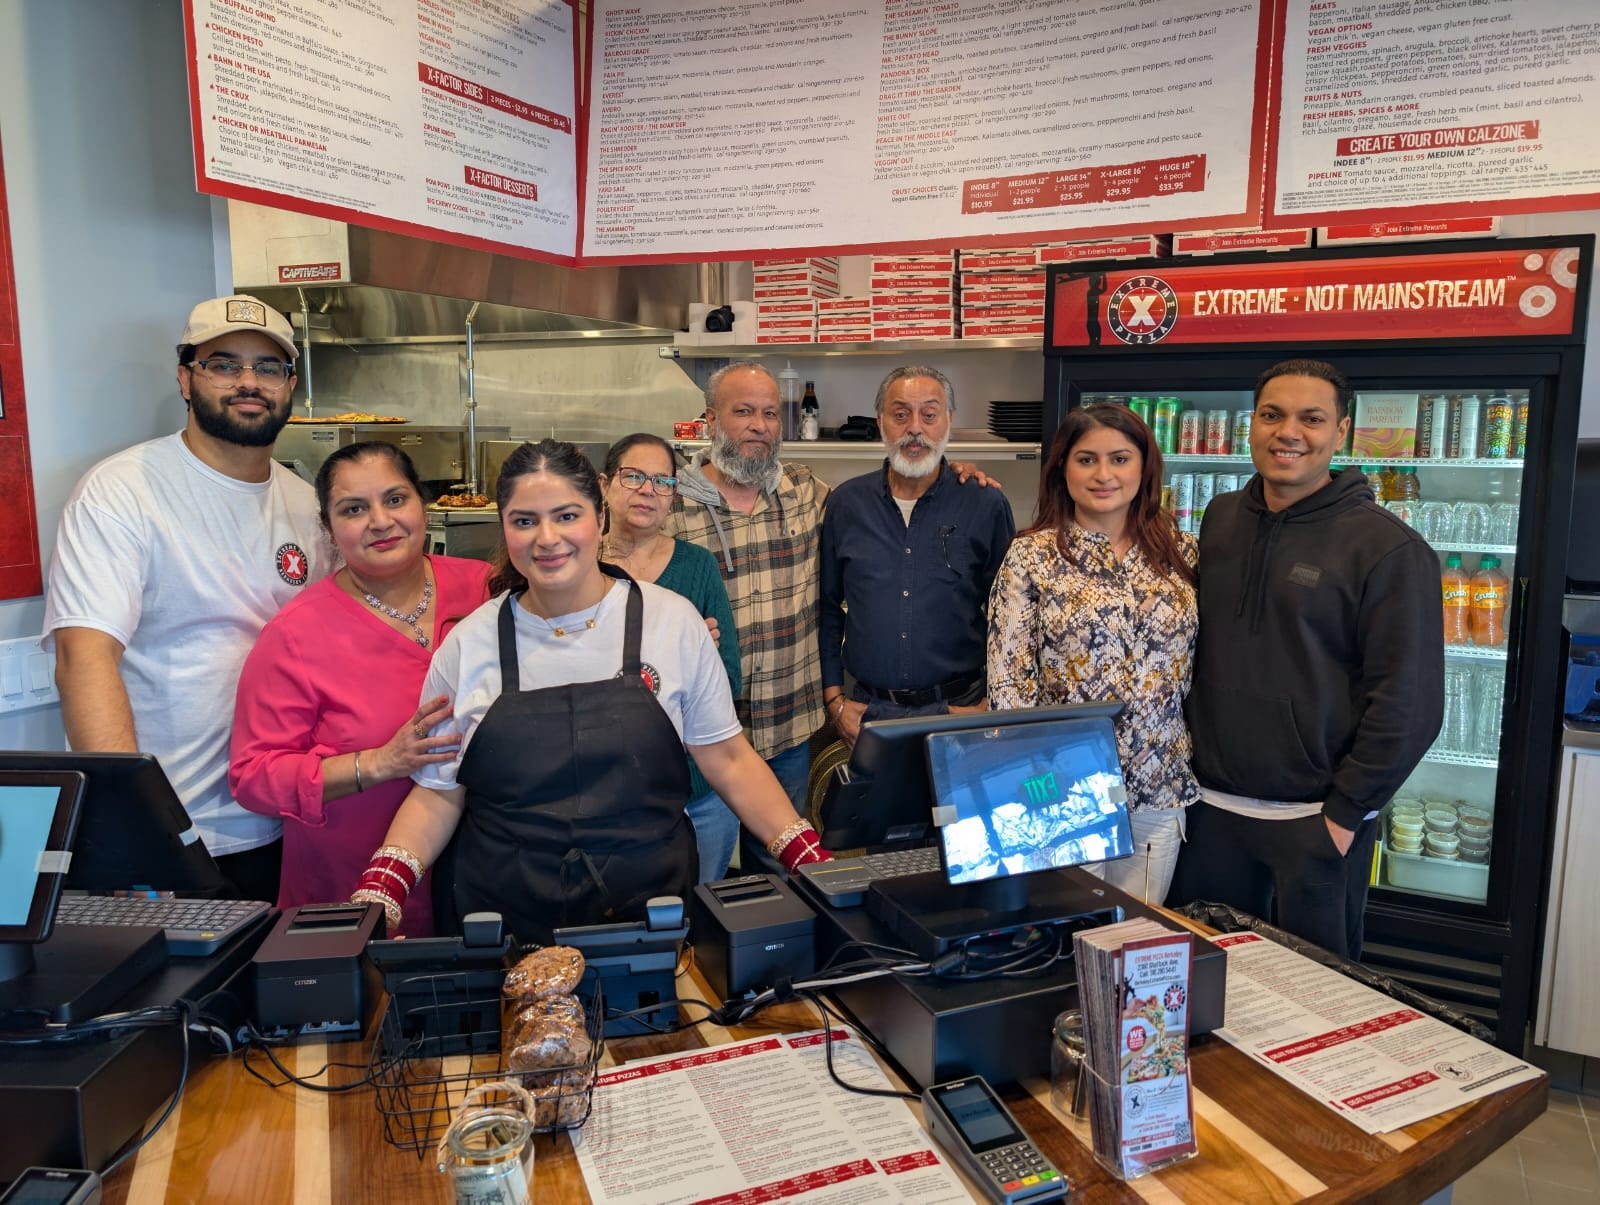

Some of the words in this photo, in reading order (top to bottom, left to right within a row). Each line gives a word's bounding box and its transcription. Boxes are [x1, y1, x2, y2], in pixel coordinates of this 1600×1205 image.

[932, 4, 959, 12] TOMATO
[1310, 2, 1336, 11] MEATS
[256, 10, 276, 22] GRIND
[212, 23, 242, 40] CHICKEN
[243, 34, 264, 48] PESTO
[1308, 27, 1335, 36] VEGAN
[1338, 22, 1372, 33] OPTIONS
[1362, 28, 1384, 39] vegan
[1418, 24, 1442, 33] vegan
[1444, 20, 1470, 30] gluten
[1472, 17, 1488, 27] free
[1306, 46, 1330, 54] FRESH
[1333, 41, 1367, 51] VEGGIES
[214, 54, 232, 66] BAHN
[234, 60, 242, 70] IN
[244, 64, 256, 74] THE
[258, 68, 272, 80] USA
[1122, 65, 1140, 76] green
[1174, 56, 1186, 66] red
[216, 85, 228, 95] THE
[230, 89, 250, 100] CRUX
[428, 67, 462, 92] X-FACTOR
[464, 84, 484, 100] SIDES
[936, 85, 960, 94] GARDEN
[1460, 85, 1494, 96] peanuts,
[1497, 80, 1520, 90] sliced
[1524, 78, 1554, 88] toasted
[495, 96, 512, 108] PIECES
[1304, 94, 1331, 102] FRUITS
[1341, 90, 1362, 98] NUTS
[1303, 111, 1326, 120] FRESH
[1329, 110, 1356, 118] HERBS,
[1359, 107, 1384, 116] SPICES
[1396, 103, 1420, 112] MORE
[218, 116, 248, 130] CHICKEN
[250, 125, 258, 134] OR
[260, 127, 293, 143] MEATBALL
[295, 136, 328, 152] PARMESAN
[1079, 144, 1102, 152] creamy
[1104, 138, 1144, 150] mascarpone
[1162, 134, 1180, 143] pesto
[1350, 136, 1396, 152] CREATE
[1399, 132, 1432, 148] YOUR
[1435, 129, 1465, 144] OWN
[1468, 123, 1526, 142] CALZONE
[1334, 158, 1358, 166] INDEE
[1403, 154, 1424, 162] $11.95
[1427, 150, 1464, 159] MEDIUM
[1518, 144, 1543, 152] $19.95
[1056, 174, 1078, 182] LARGE
[1100, 168, 1132, 178] X-LARGE
[1160, 163, 1180, 172] HUGE
[1308, 171, 1342, 180] PIPELINE
[1344, 167, 1372, 176] Tomato
[1478, 158, 1507, 167] pureed
[1510, 156, 1534, 164] garlic
[470, 169, 502, 190] X-FACTOR
[503, 178, 534, 198] DESSERTS
[1118, 178, 1140, 186] people
[1170, 171, 1192, 180] people
[1060, 192, 1082, 201] $25.95
[1106, 188, 1131, 197] $29.95
[1159, 182, 1184, 191] $33.95
[1111, 278, 1175, 310] EXTREME
[1194, 288, 1288, 316] EXTREME
[1305, 284, 1348, 312] NOT
[1353, 278, 1506, 311] MAINSTREAM
[1126, 295, 1158, 326] X
[1116, 326, 1168, 344] PIZZA
[1423, 400, 1433, 458] FIELDWORK
[1451, 400, 1461, 457] FIELDWORK
[286, 554, 301, 574] X
[1443, 590, 1467, 600] Crush
[1474, 592, 1498, 602] Crush
[1170, 992, 1180, 1004] X
[1130, 1030, 1144, 1038] WE
[617, 1070, 642, 1080] PIZZAS
